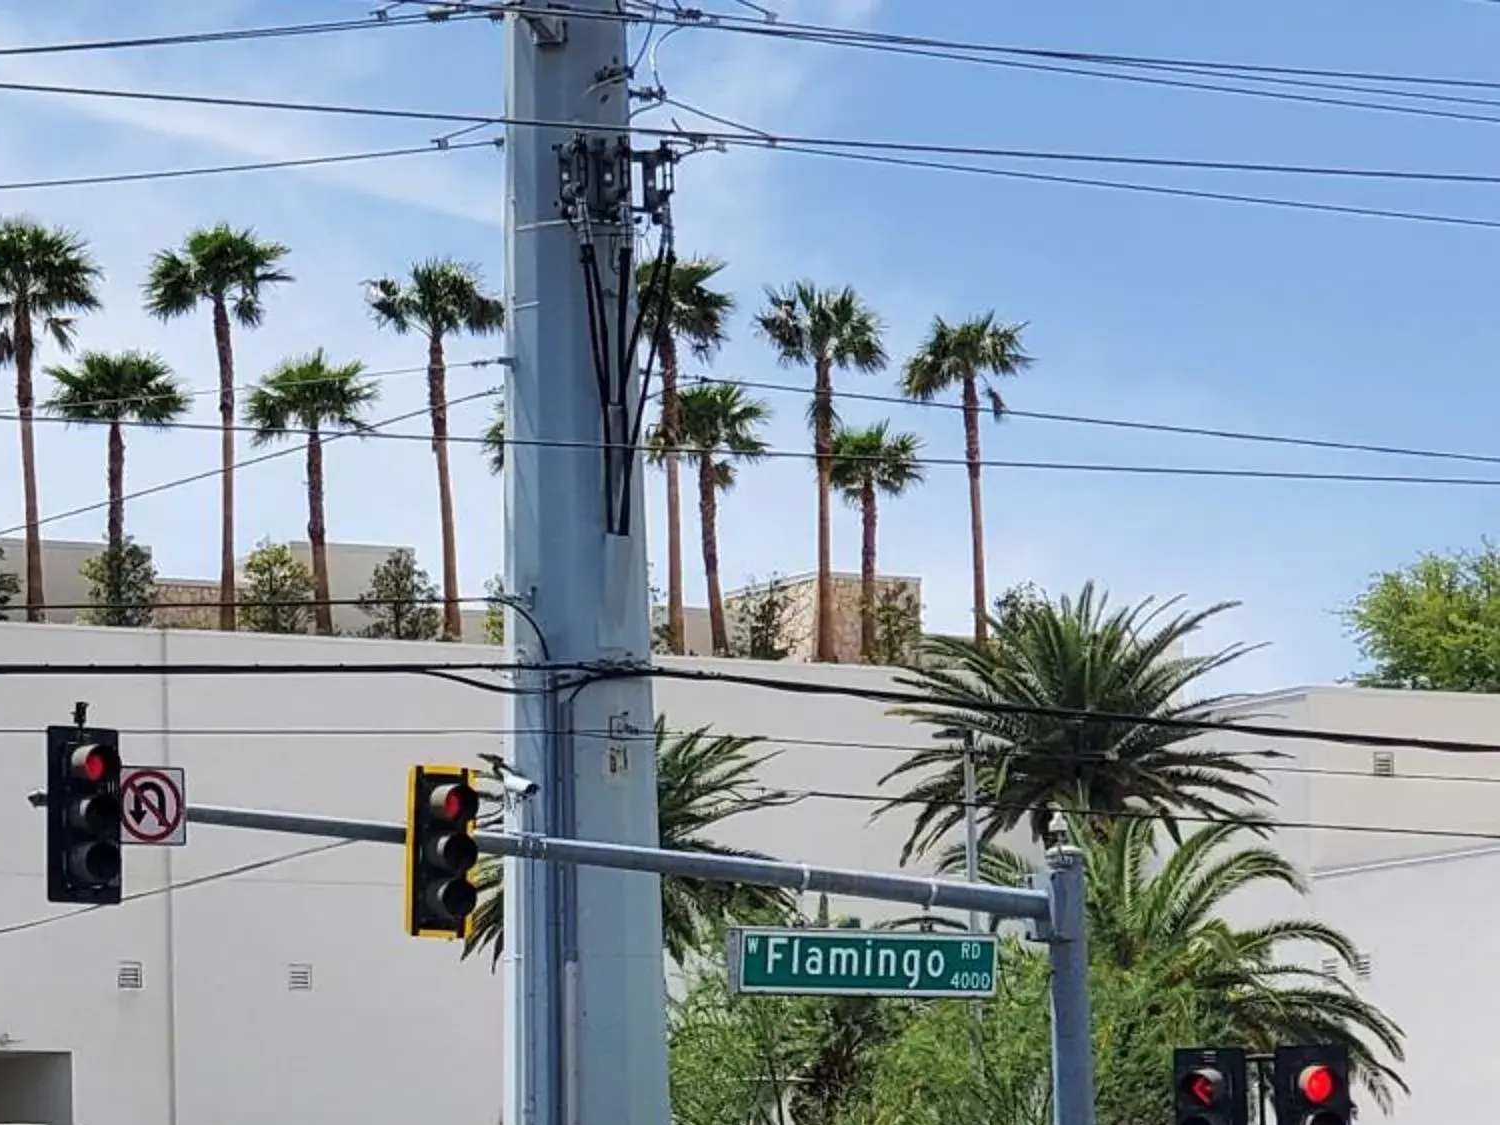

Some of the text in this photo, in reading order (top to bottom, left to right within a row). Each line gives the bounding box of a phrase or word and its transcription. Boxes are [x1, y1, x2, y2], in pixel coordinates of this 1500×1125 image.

[747, 937, 982, 989] W Flamingo RD
[949, 971, 991, 990] 4000
